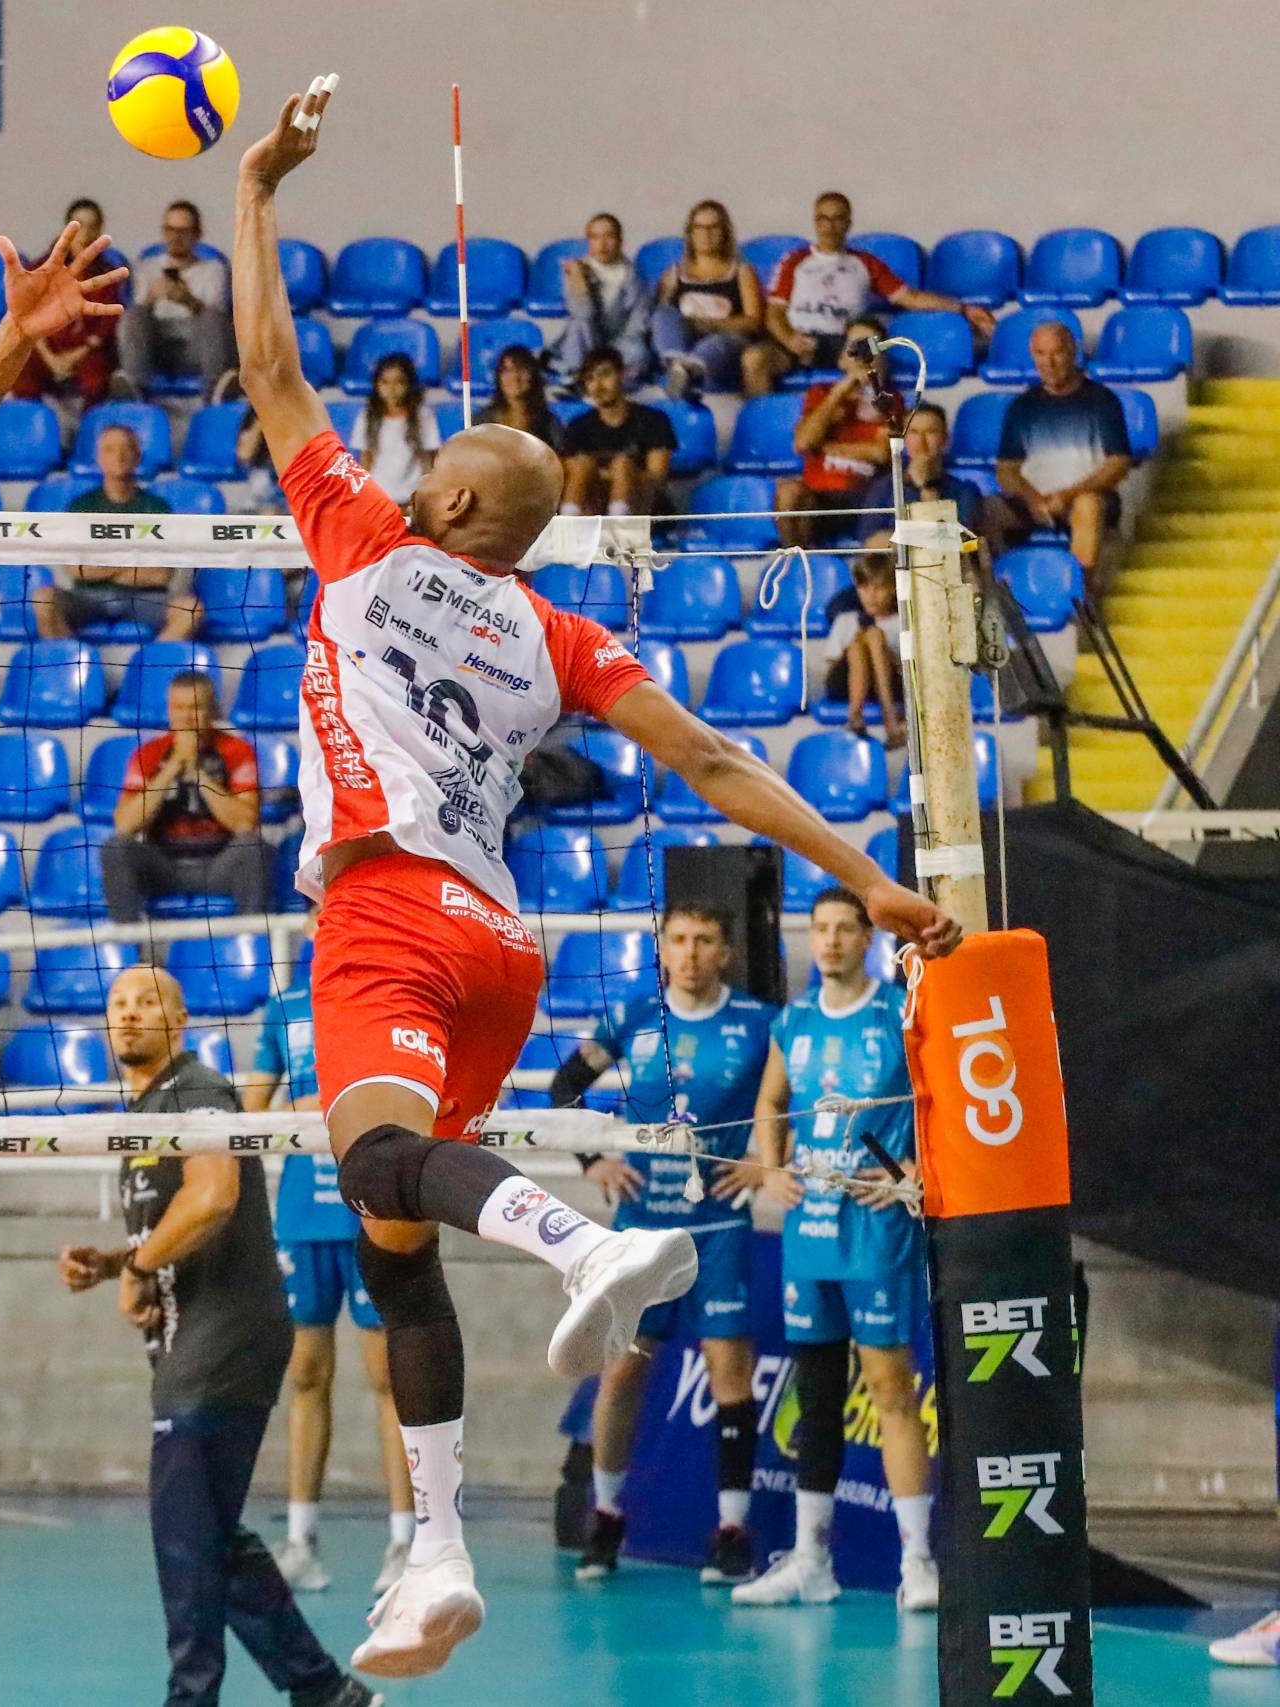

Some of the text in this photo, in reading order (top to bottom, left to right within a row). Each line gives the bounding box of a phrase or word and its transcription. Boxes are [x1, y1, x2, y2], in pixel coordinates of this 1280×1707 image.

[90, 524, 164, 540] BET7K
[212, 524, 286, 541] BET7K
[390, 615, 410, 633] HR
[413, 628, 439, 648] SUL
[446, 590, 521, 638] METASUL
[464, 652, 532, 692] Hennings
[951, 995, 1023, 1146] GOL
[108, 1135, 182, 1152] BET7K
[229, 1134, 302, 1150] BET7K
[961, 1297, 1048, 1334] BET
[964, 1331, 1052, 1382] 7K
[977, 1452, 1061, 1489] BET
[980, 1487, 1065, 1539] 7K
[989, 1612, 1071, 1647] BET
[991, 1647, 1072, 1698] 7K
